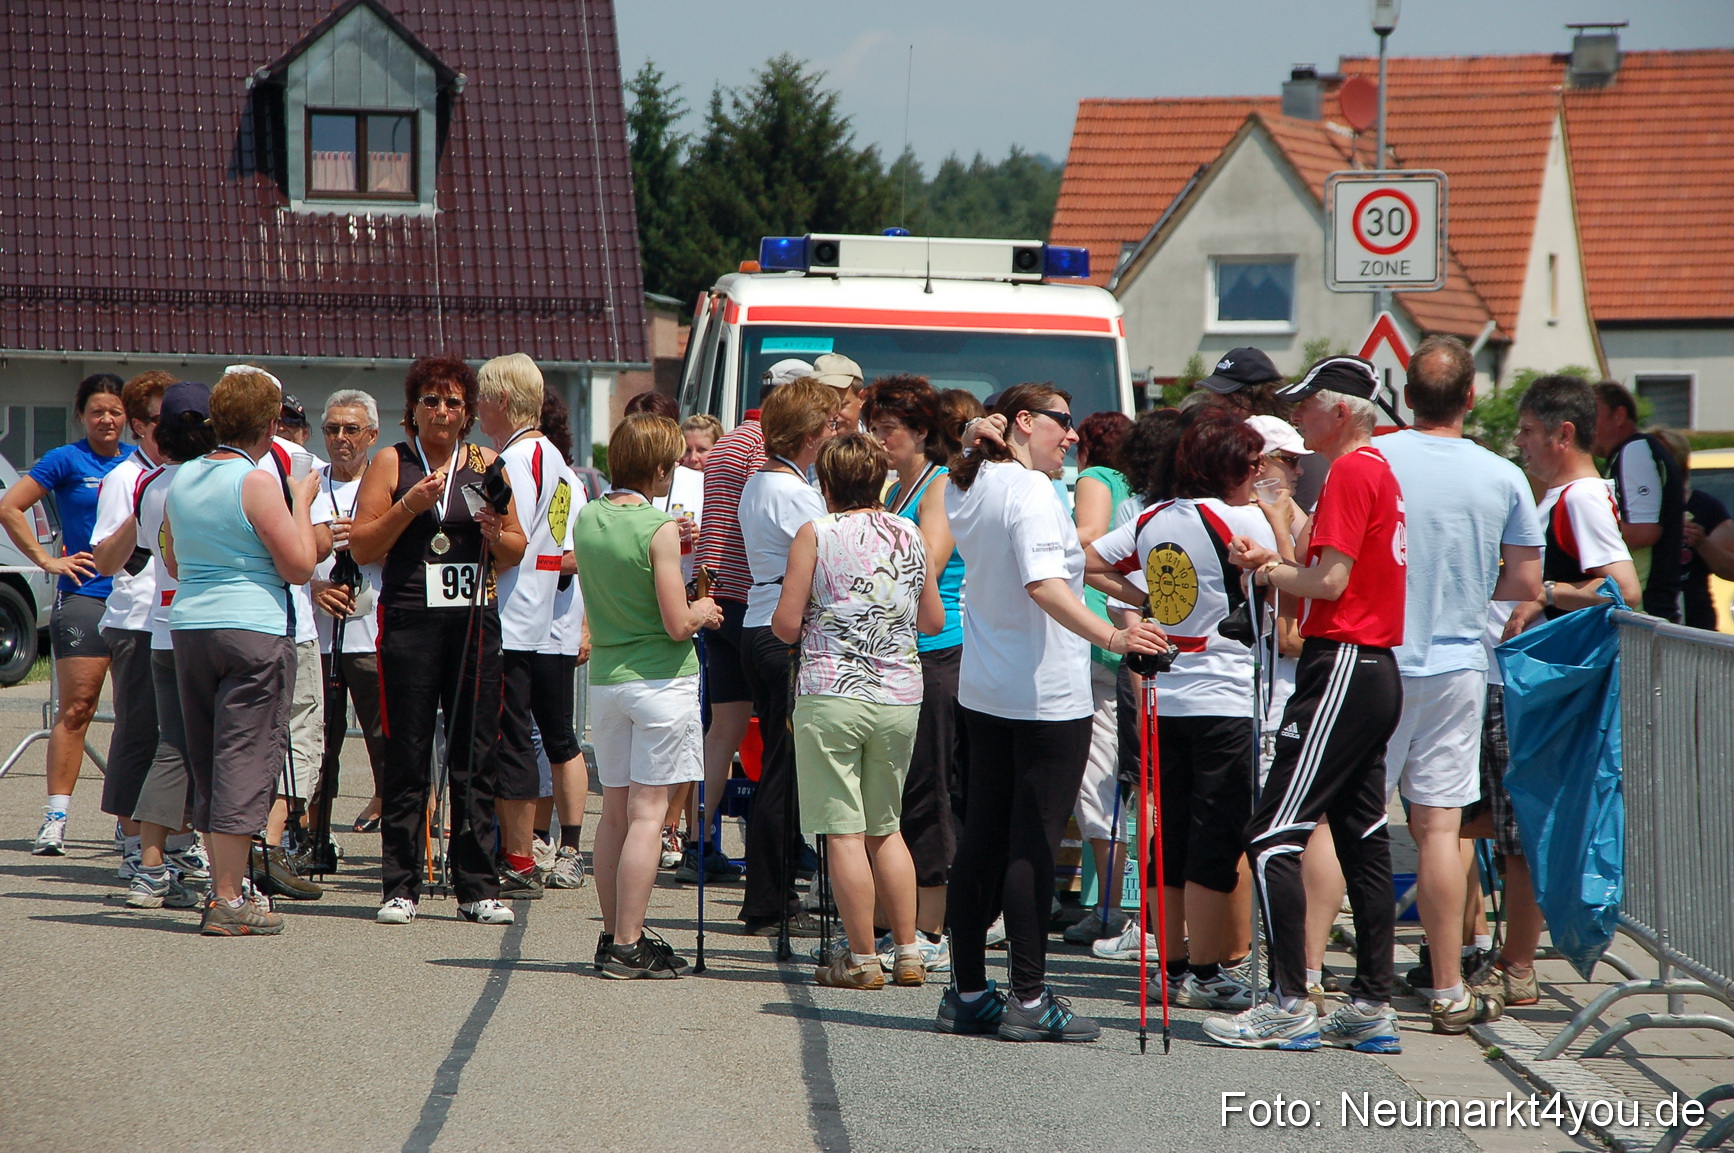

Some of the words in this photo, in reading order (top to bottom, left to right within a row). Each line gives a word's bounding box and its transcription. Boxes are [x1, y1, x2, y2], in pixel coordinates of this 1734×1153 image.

[1366, 206, 1406, 237] 30
[1360, 259, 1412, 276] ZONE
[1165, 552, 1172, 563] 12
[1173, 557, 1180, 569] 11
[1179, 567, 1188, 579] 10
[441, 565, 476, 600] 93
